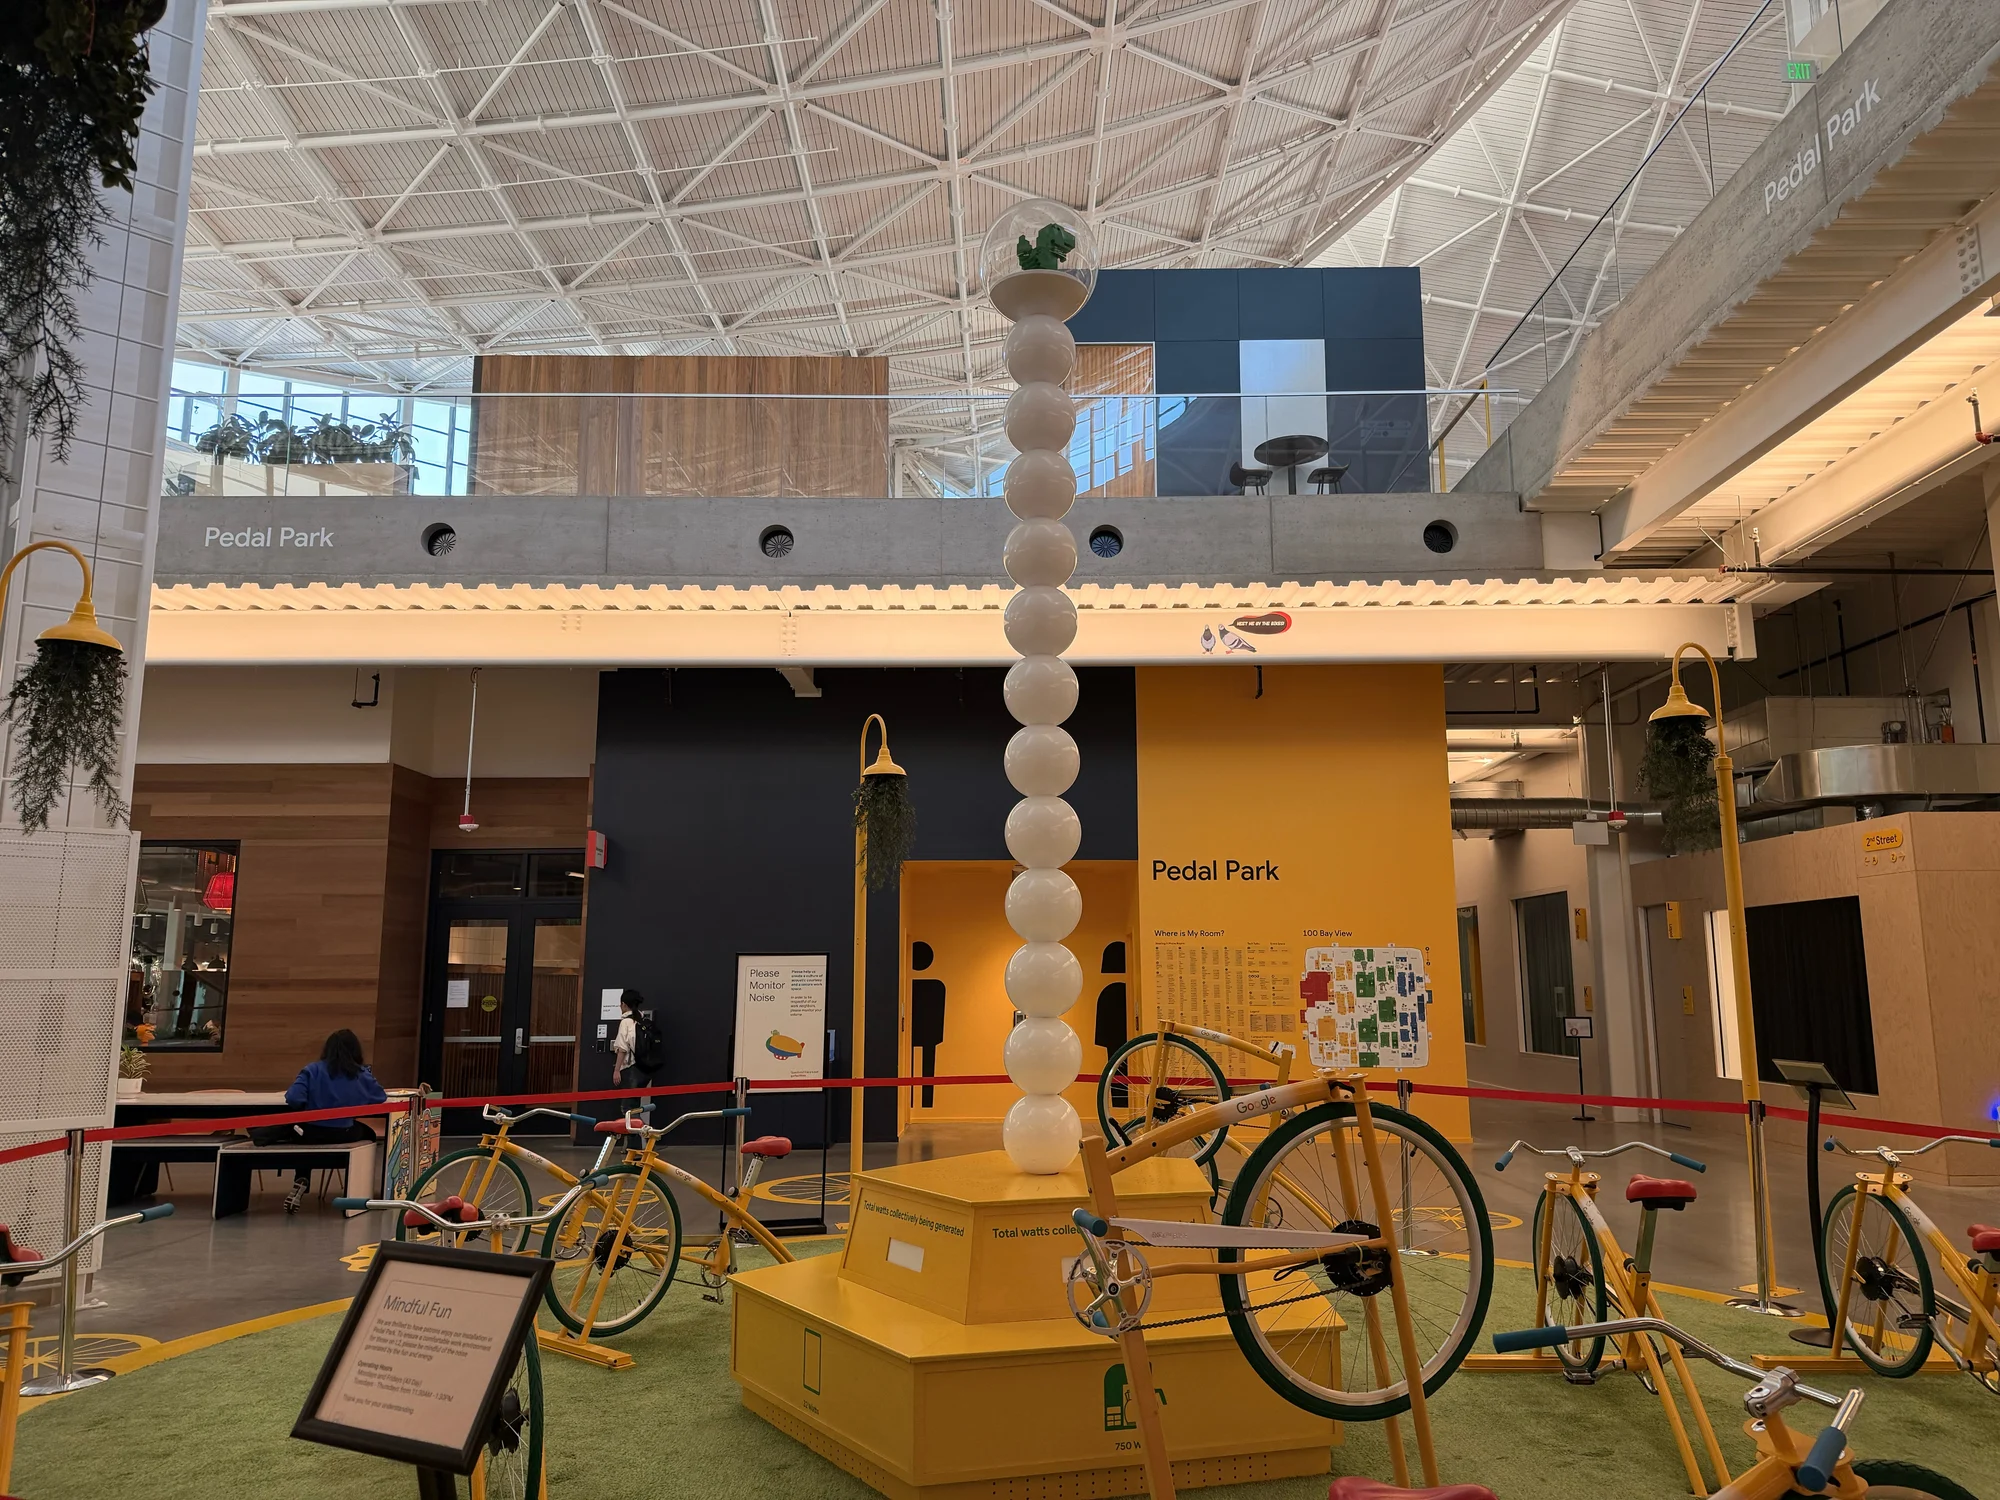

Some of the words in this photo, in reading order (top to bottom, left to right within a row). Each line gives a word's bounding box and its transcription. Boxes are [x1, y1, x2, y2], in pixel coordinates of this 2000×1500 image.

[1787, 63, 1811, 80] EXIT
[1764, 132, 1822, 215] Pedal
[1826, 77, 1881, 152] Park
[204, 526, 272, 548] Pedal
[279, 527, 335, 548] Park
[1865, 837, 1875, 847] 2nd
[1875, 834, 1898, 846] Street
[1152, 860, 1218, 881] Pedal
[1226, 860, 1280, 881] Park
[1575, 908, 1581, 916] K
[1667, 903, 1673, 911] L
[1187, 930, 1198, 938] My
[1320, 930, 1333, 938] Bay
[750, 969, 780, 978] Please
[749, 981, 786, 990] Monitor
[749, 993, 776, 1002] Noise
[1200, 1029, 1221, 1040] Gogle
[1236, 1094, 1277, 1114] Google
[527, 1151, 543, 1164] Gogle
[675, 1168, 692, 1182] Gogle
[863, 1200, 876, 1211] Total
[875, 1206, 889, 1216] watts
[889, 1208, 918, 1226] collectively
[919, 1215, 935, 1231] being
[934, 1221, 965, 1237] generated
[1904, 1206, 1921, 1227] Gogle
[992, 1227, 1019, 1239] Total
[1020, 1226, 1050, 1238] watts
[383, 1295, 430, 1316] Mindful
[429, 1302, 453, 1319] Fun
[391, 1320, 407, 1329] thrilled
[423, 1326, 441, 1335] patrons
[441, 1329, 453, 1338] enjoy
[461, 1331, 487, 1341] installation
[403, 1332, 419, 1340] ensure
[422, 1334, 451, 1345] comfortable
[450, 1338, 462, 1346] work
[461, 1340, 492, 1352] environment
[402, 1340, 418, 1349] please
[424, 1343, 441, 1353] mindful
[447, 1347, 455, 1356] the
[454, 1350, 468, 1358] noise
[408, 1350, 418, 1359] and
[357, 1360, 379, 1370] Operating
[379, 1364, 393, 1372] Hours
[357, 1368, 377, 1379] Mondays
[377, 1373, 387, 1381] and
[386, 1374, 402, 1384] Fridays
[399, 1386, 411, 1394] from
[343, 1393, 355, 1402] Thank
[1115, 1442, 1132, 1451] 750
